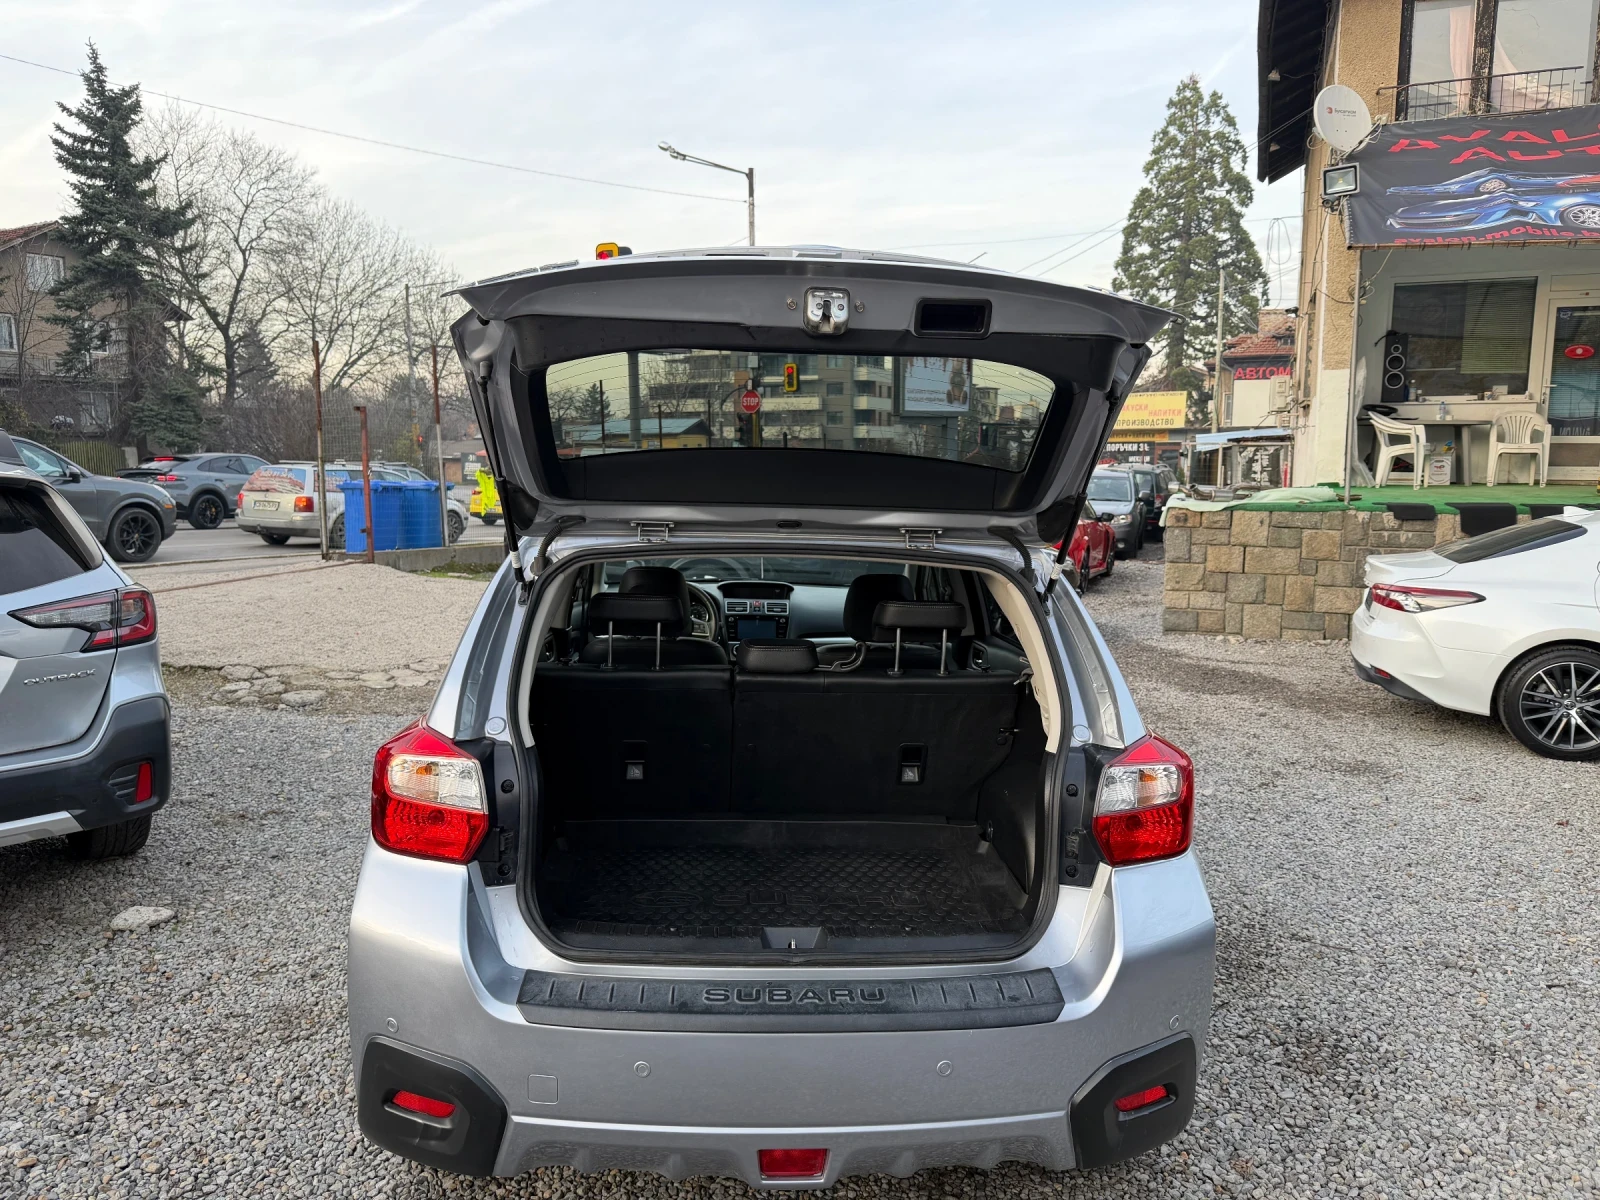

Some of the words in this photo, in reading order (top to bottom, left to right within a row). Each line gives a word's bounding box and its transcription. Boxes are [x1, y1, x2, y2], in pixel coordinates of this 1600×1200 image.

[1388, 123, 1600, 152] AVAL
[742, 397, 759, 406] STOP
[1148, 408, 1182, 417] НАПИТКИ
[1116, 418, 1175, 427] ПРОИЗВОДСТВО
[23, 668, 97, 686] OUTBACK
[703, 987, 887, 1004] SUBARU
